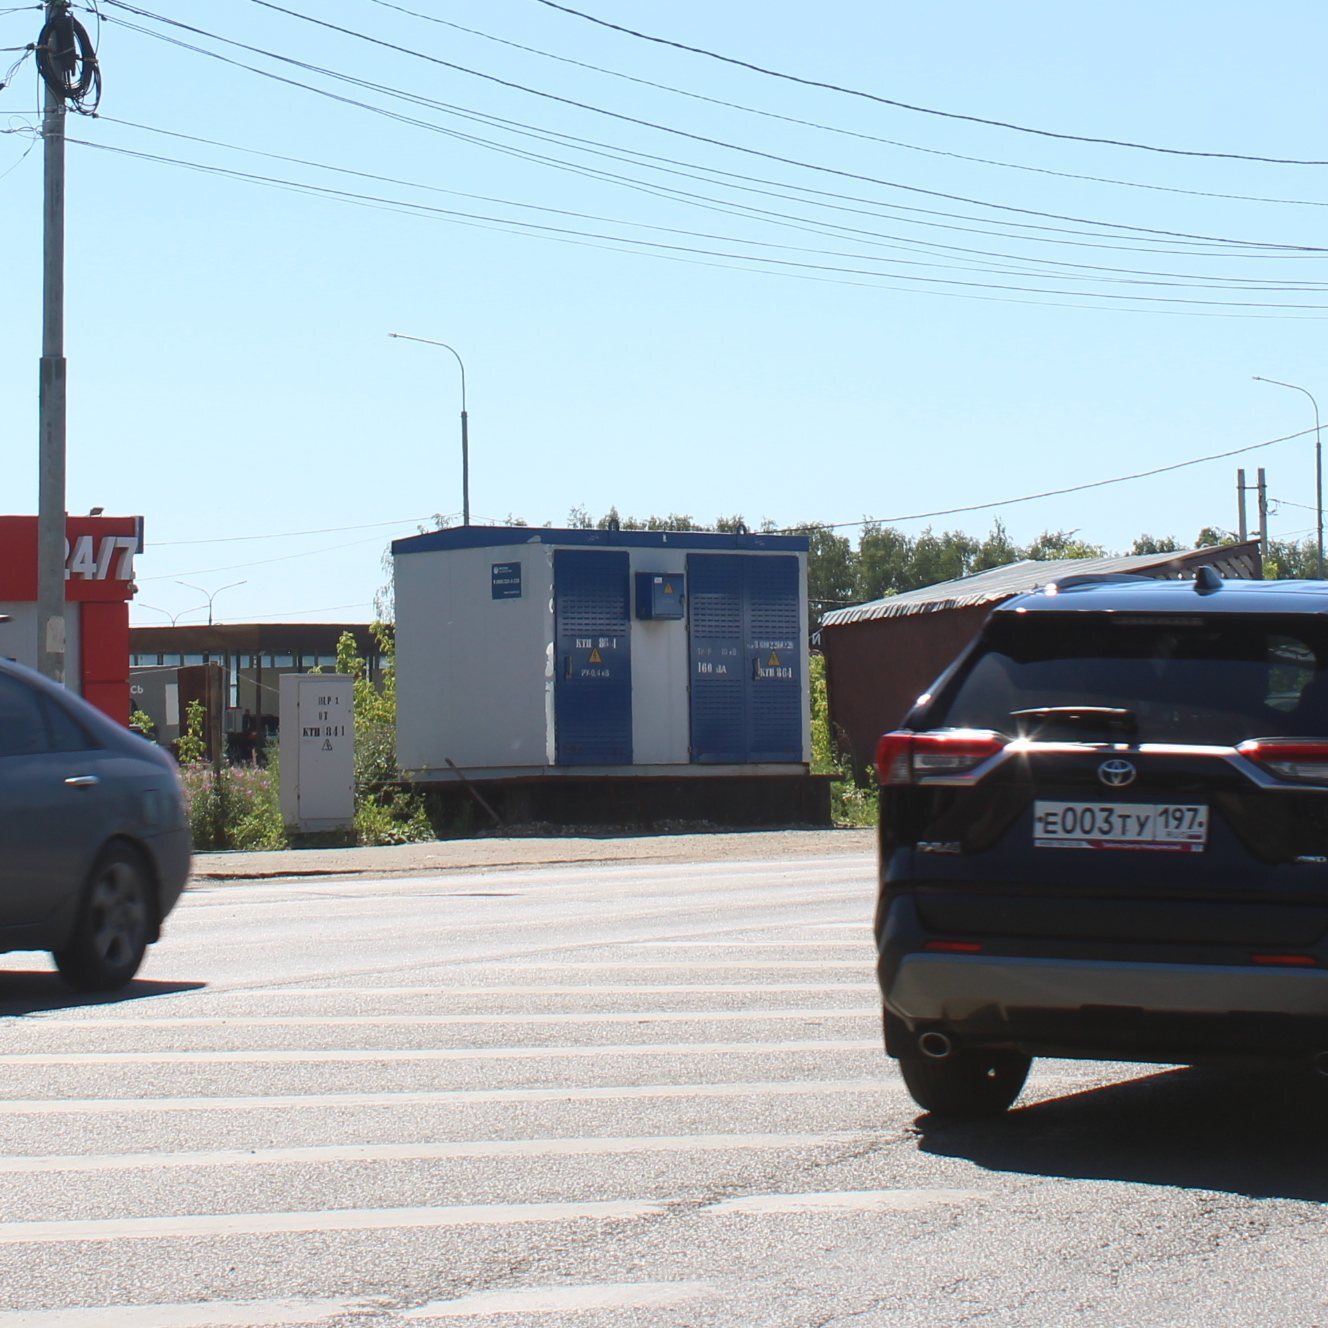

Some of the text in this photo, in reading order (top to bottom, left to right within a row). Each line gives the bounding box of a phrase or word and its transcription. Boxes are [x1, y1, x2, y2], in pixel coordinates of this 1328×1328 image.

[65, 535, 139, 581] 4/7
[1043, 807, 1199, 836] Е003ТУ 197
